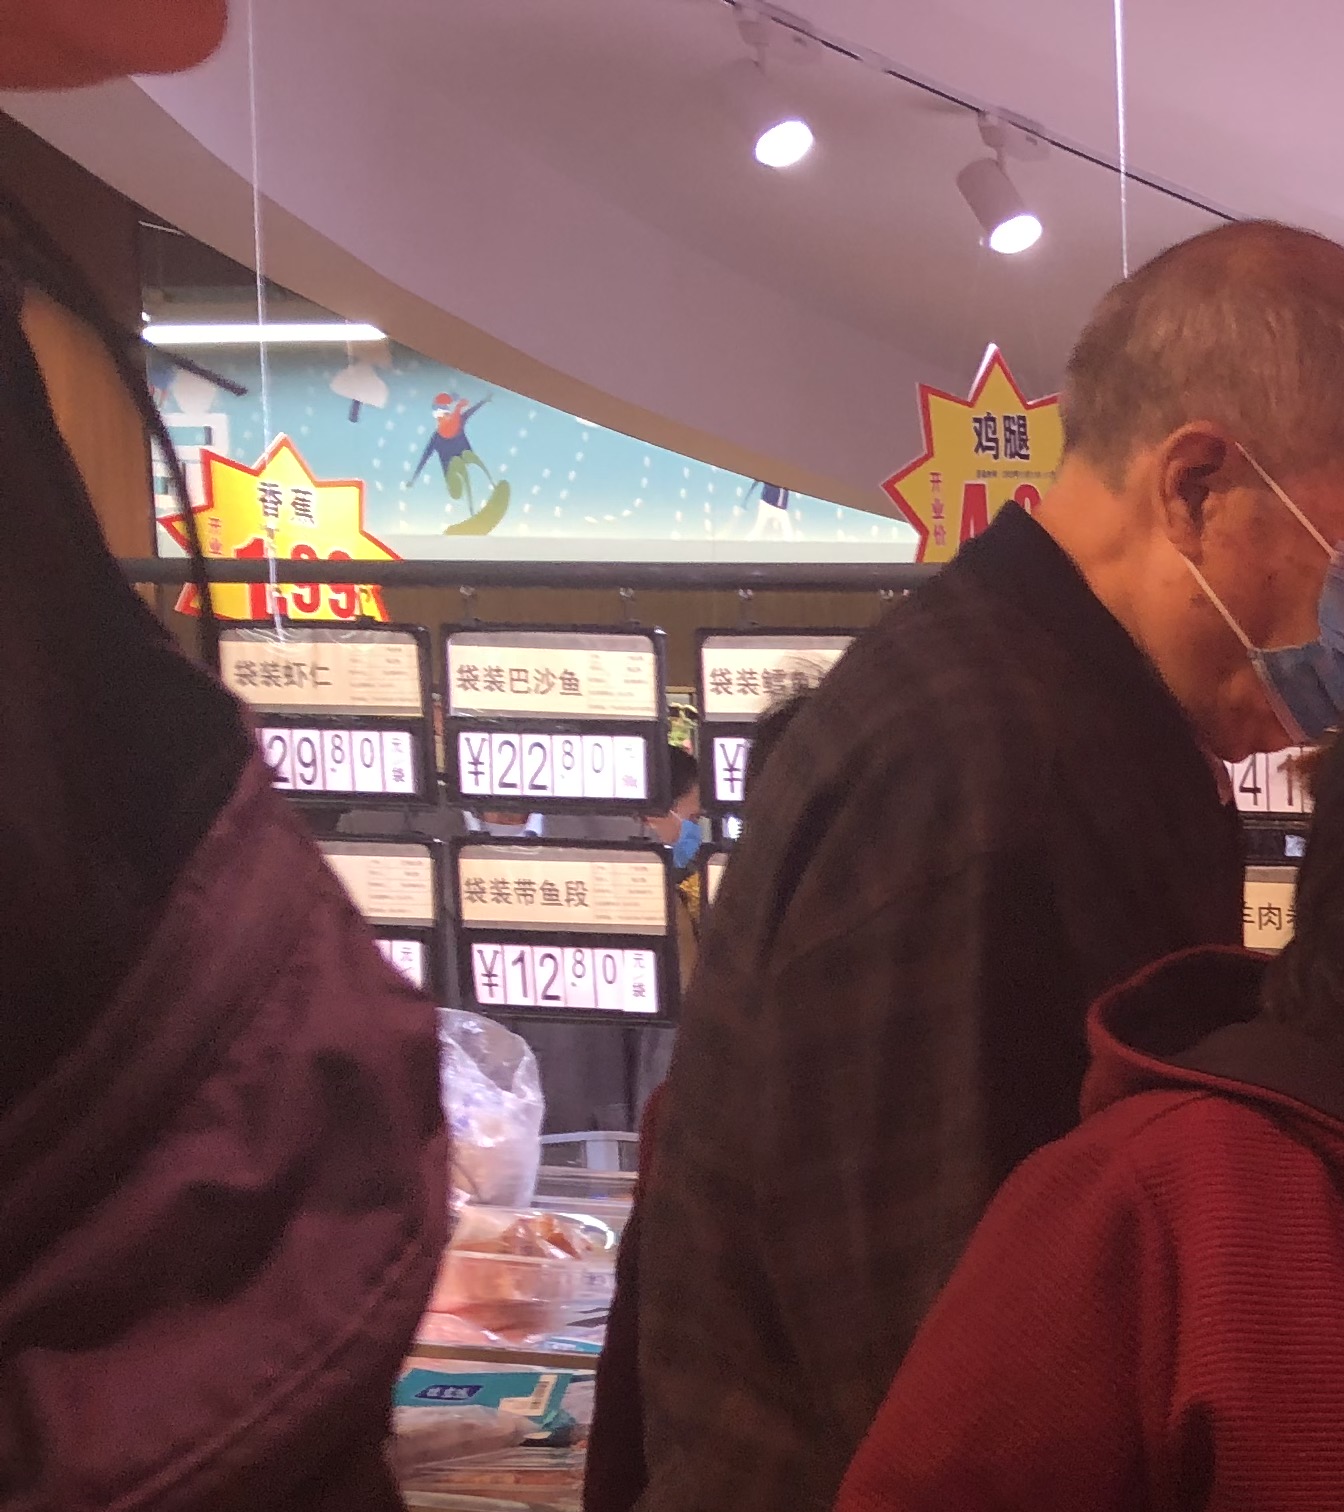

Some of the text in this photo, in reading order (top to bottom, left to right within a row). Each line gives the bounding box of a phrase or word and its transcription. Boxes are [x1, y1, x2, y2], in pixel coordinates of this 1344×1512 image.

[972, 412, 1030, 460] 鸡腿
[258, 481, 315, 524] 香蕉
[234, 660, 333, 688] 袋装虾仁
[456, 664, 583, 696] 袋装巴沙鱼
[464, 878, 589, 907] 袋装带鱼段
